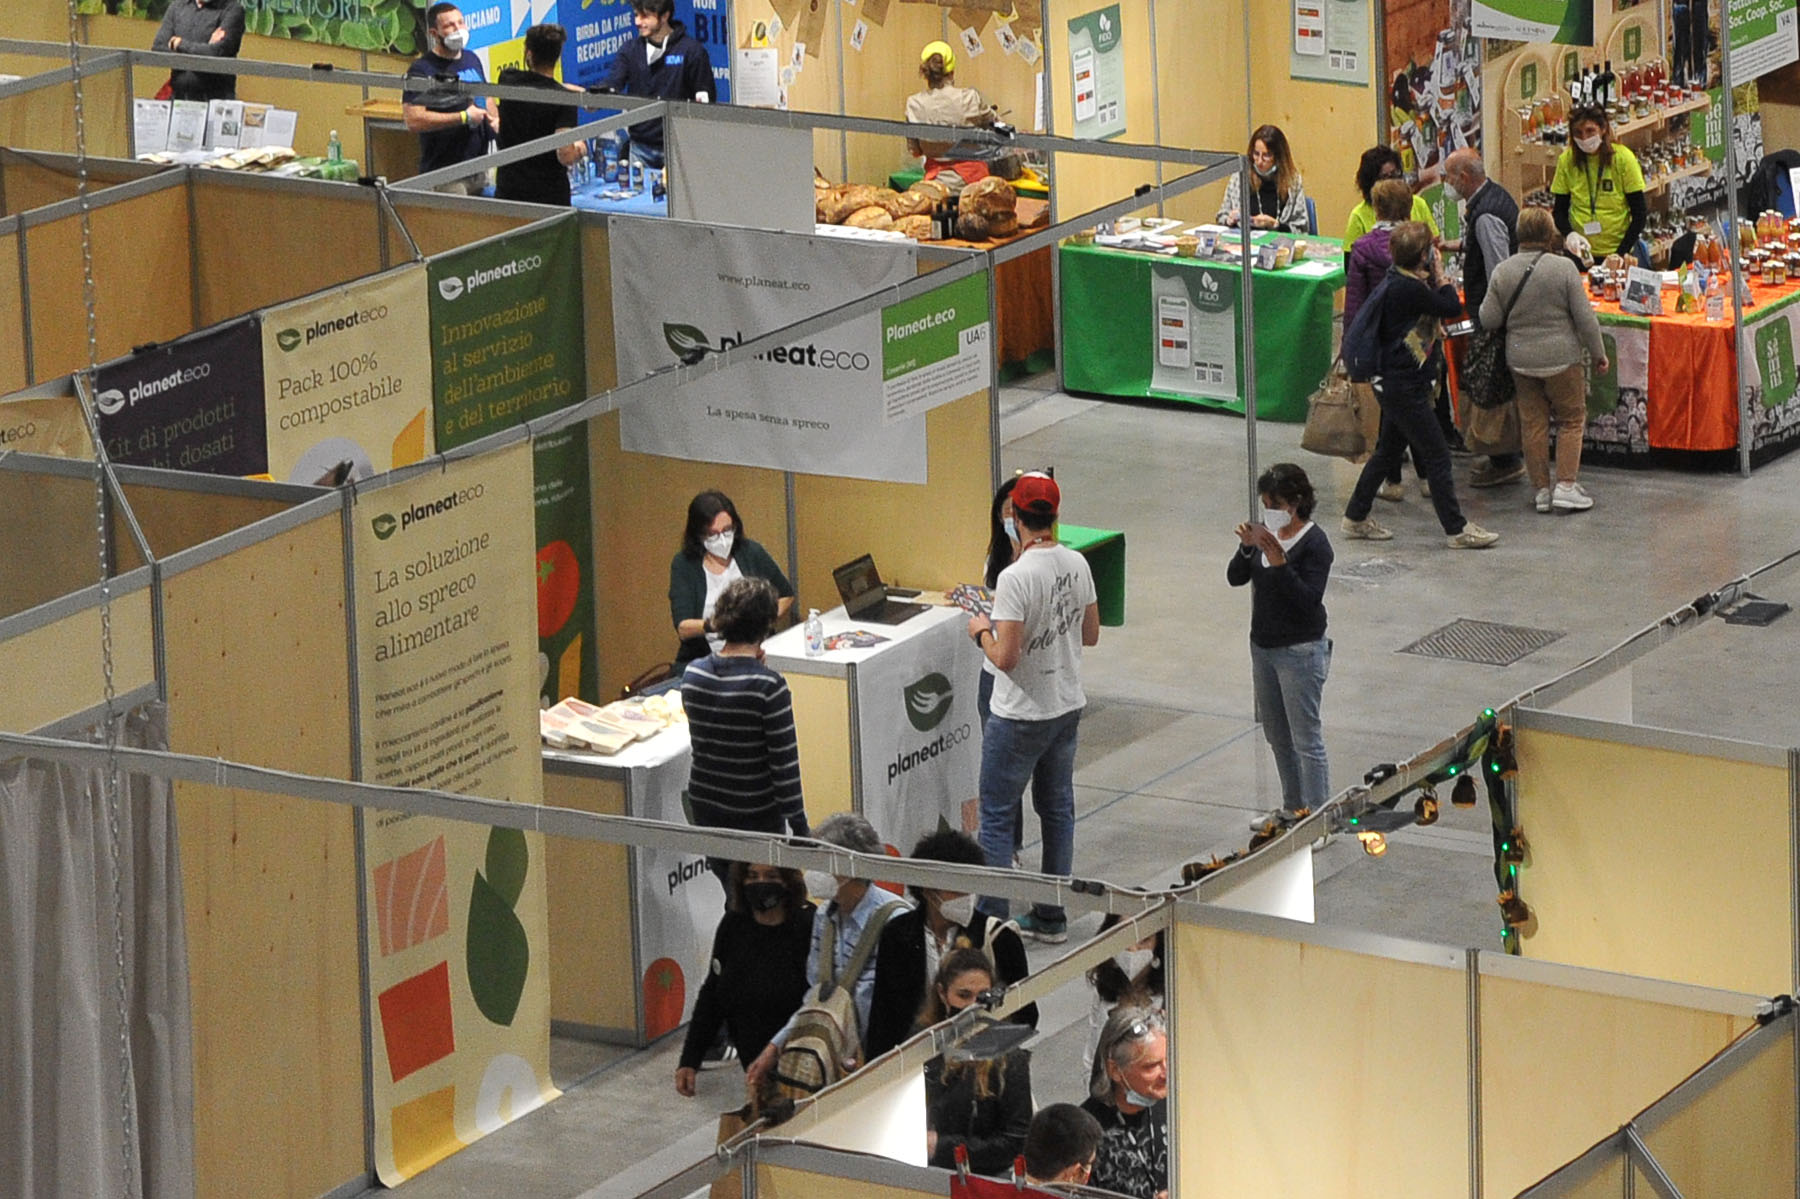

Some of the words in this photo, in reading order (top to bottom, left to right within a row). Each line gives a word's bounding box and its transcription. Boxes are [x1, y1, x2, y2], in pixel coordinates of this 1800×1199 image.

[575, 21, 600, 43] BIRRA
[602, 18, 614, 35] DA
[613, 11, 632, 31] PANE
[1098, 30, 1113, 42] FIDO
[1728, 13, 1746, 31] Soc.
[1746, 5, 1768, 26] Coop.
[1705, 129, 1722, 149] na
[467, 255, 542, 294] planeat.eco
[717, 271, 811, 292] www.planeat.eco
[1199, 290, 1219, 302] FIDO
[441, 295, 546, 346] Innovazione
[886, 305, 957, 344] Planeat.eco
[966, 327, 987, 346] UA6
[442, 356, 458, 376] al
[463, 330, 533, 369] servizio
[129, 362, 211, 407] planeat.eco
[278, 369, 323, 401] Pack
[329, 351, 378, 385] 100%
[443, 351, 555, 406] dell'ambiente
[163, 396, 236, 443] prodotti
[279, 375, 403, 431] compostabile
[445, 423, 454, 435] e
[458, 409, 483, 431] del
[489, 379, 571, 419] territorio
[706, 405, 722, 418] La
[725, 409, 756, 424] spesa
[759, 412, 790, 426] senza
[791, 415, 830, 431] spreco
[179, 428, 235, 466] dosati
[374, 569, 400, 595] La
[404, 531, 491, 582] soluzione
[374, 597, 413, 629] allo
[418, 571, 477, 615] spreco
[374, 604, 480, 663] alimentare
[886, 723, 971, 786] planeat.eco
